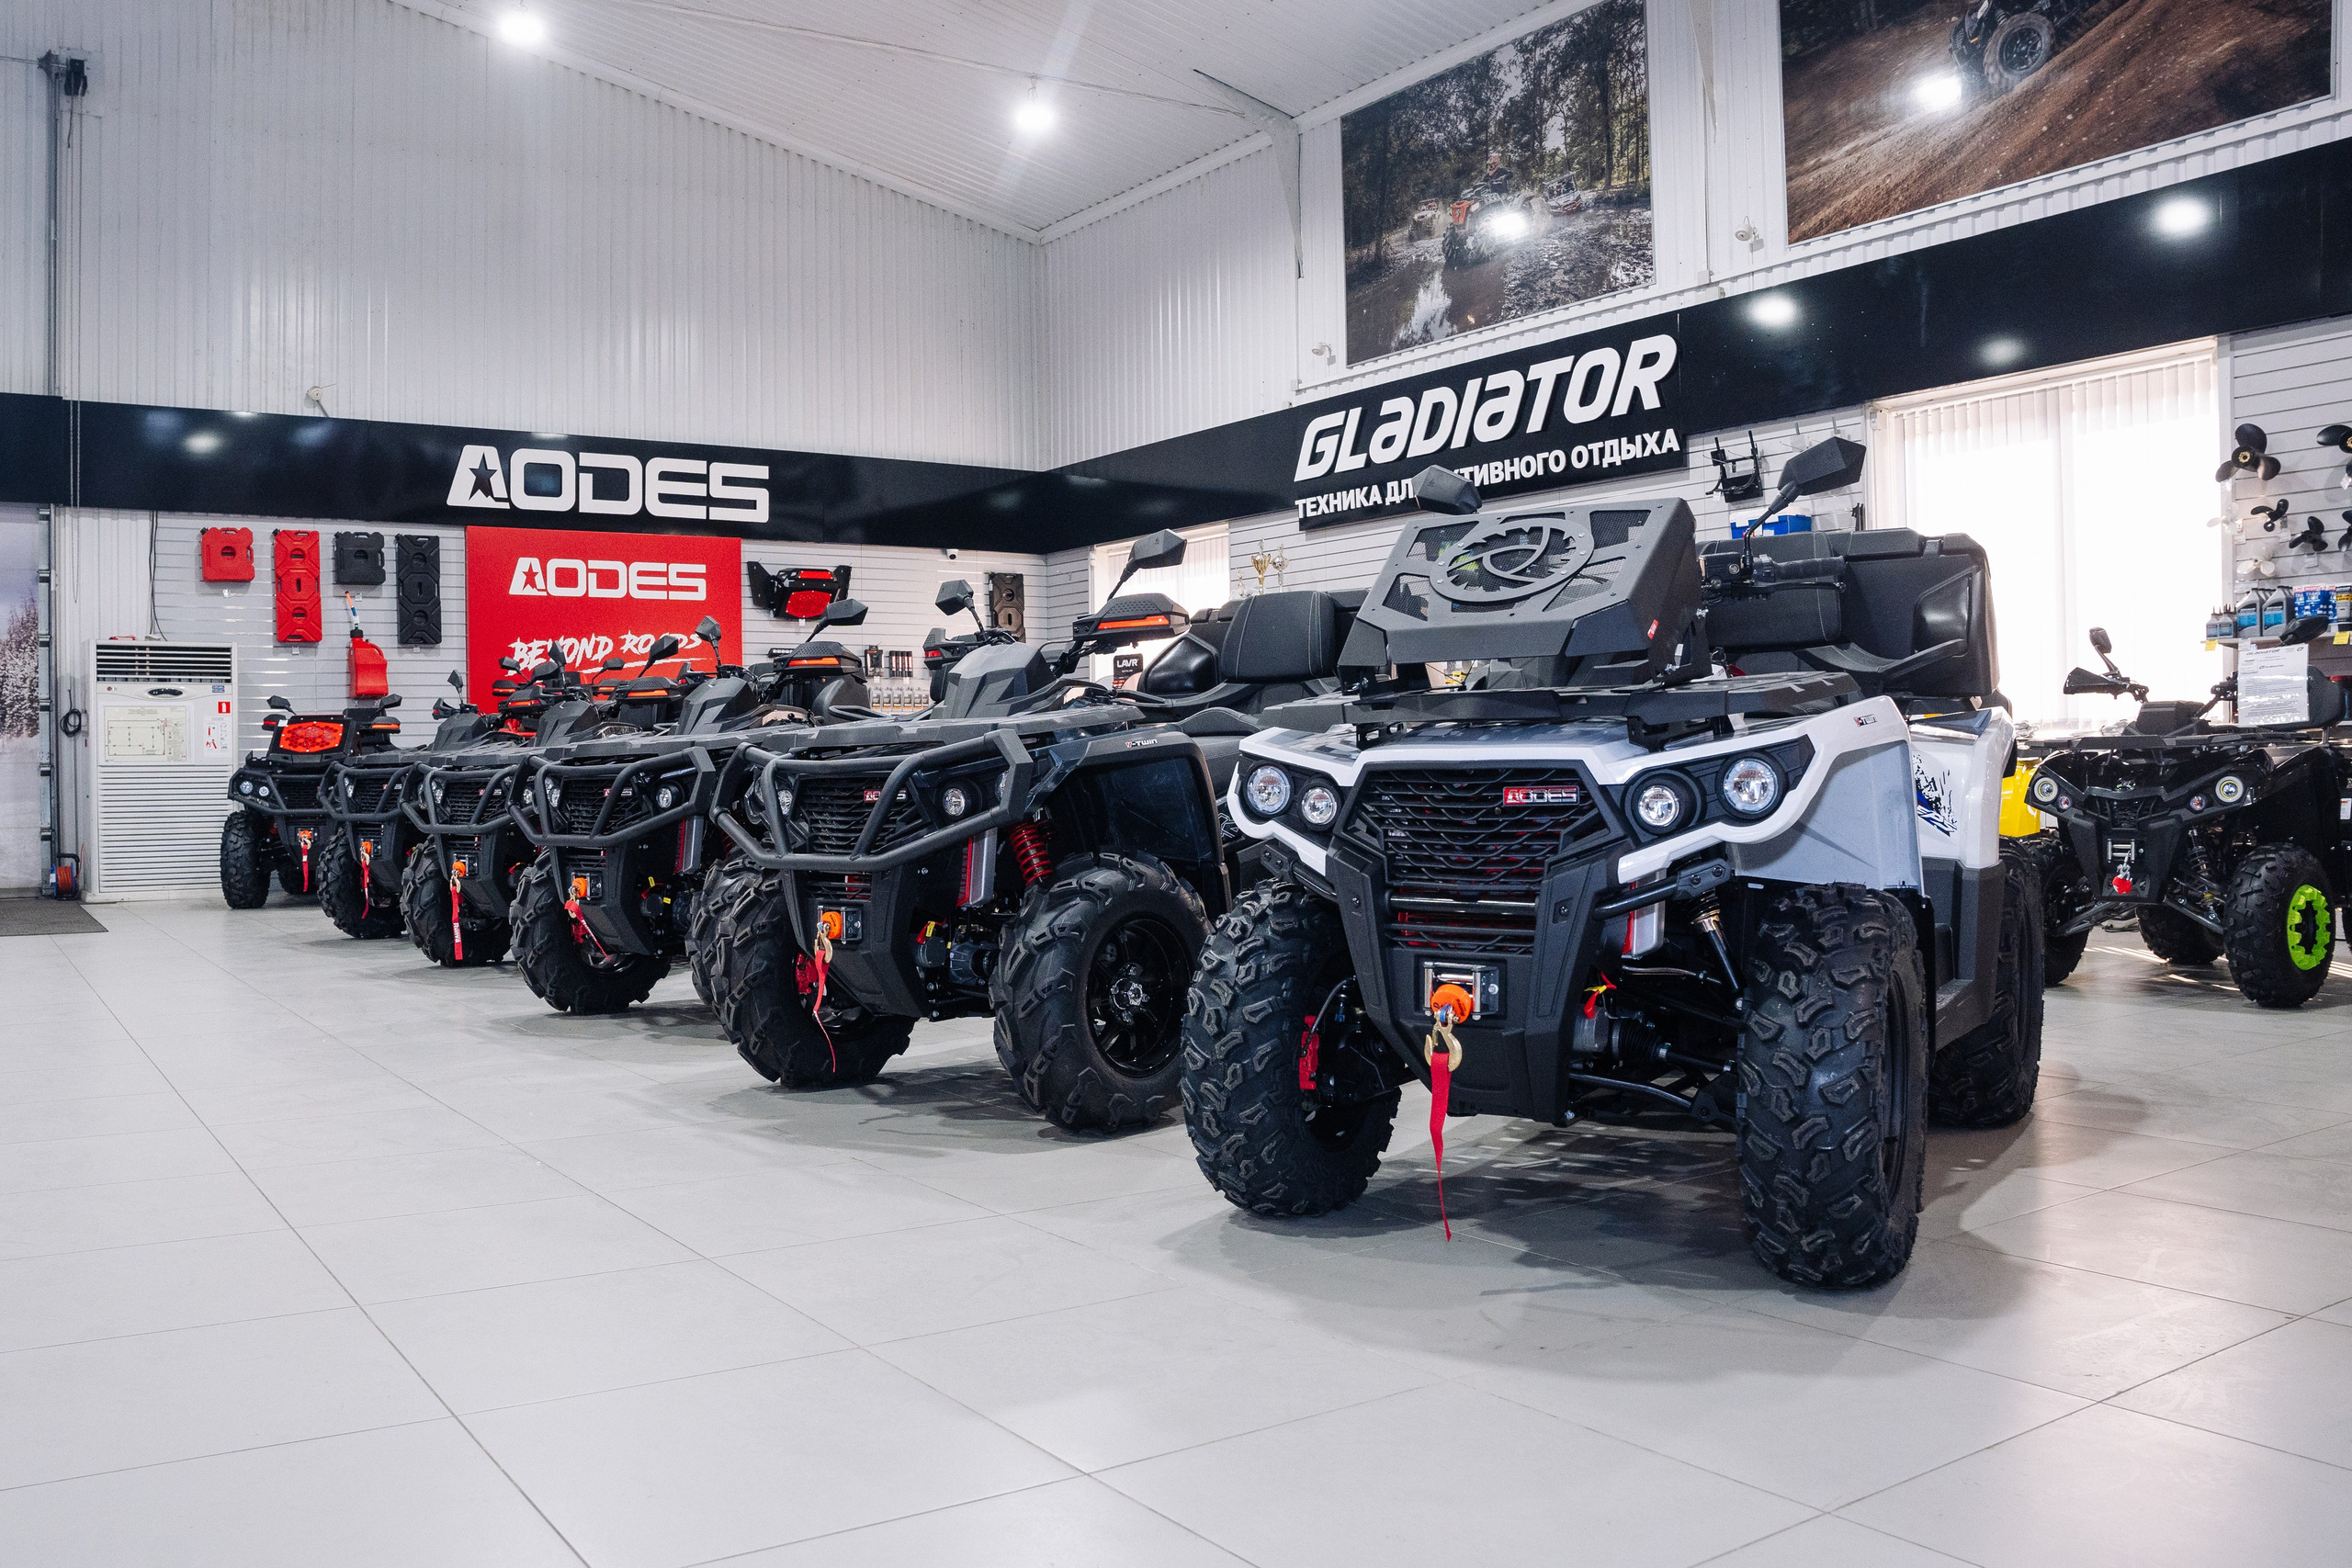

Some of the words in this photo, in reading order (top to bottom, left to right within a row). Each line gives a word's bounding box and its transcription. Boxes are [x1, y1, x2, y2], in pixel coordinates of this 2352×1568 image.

[447, 445, 769, 523] AODES
[1295, 484, 1383, 519] ТЕХНИКА
[1385, 478, 1418, 506] ДЛ
[1452, 449, 1566, 487] ТИВНОГО
[1570, 428, 1680, 468] ОТДЫХА
[508, 557, 707, 601] AODES
[504, 633, 614, 677] BEOND
[619, 630, 705, 656] RODS
[1116, 659, 1138, 668] LAVR
[865, 790, 907, 800] AOS
[1506, 789, 1577, 803] AODES
